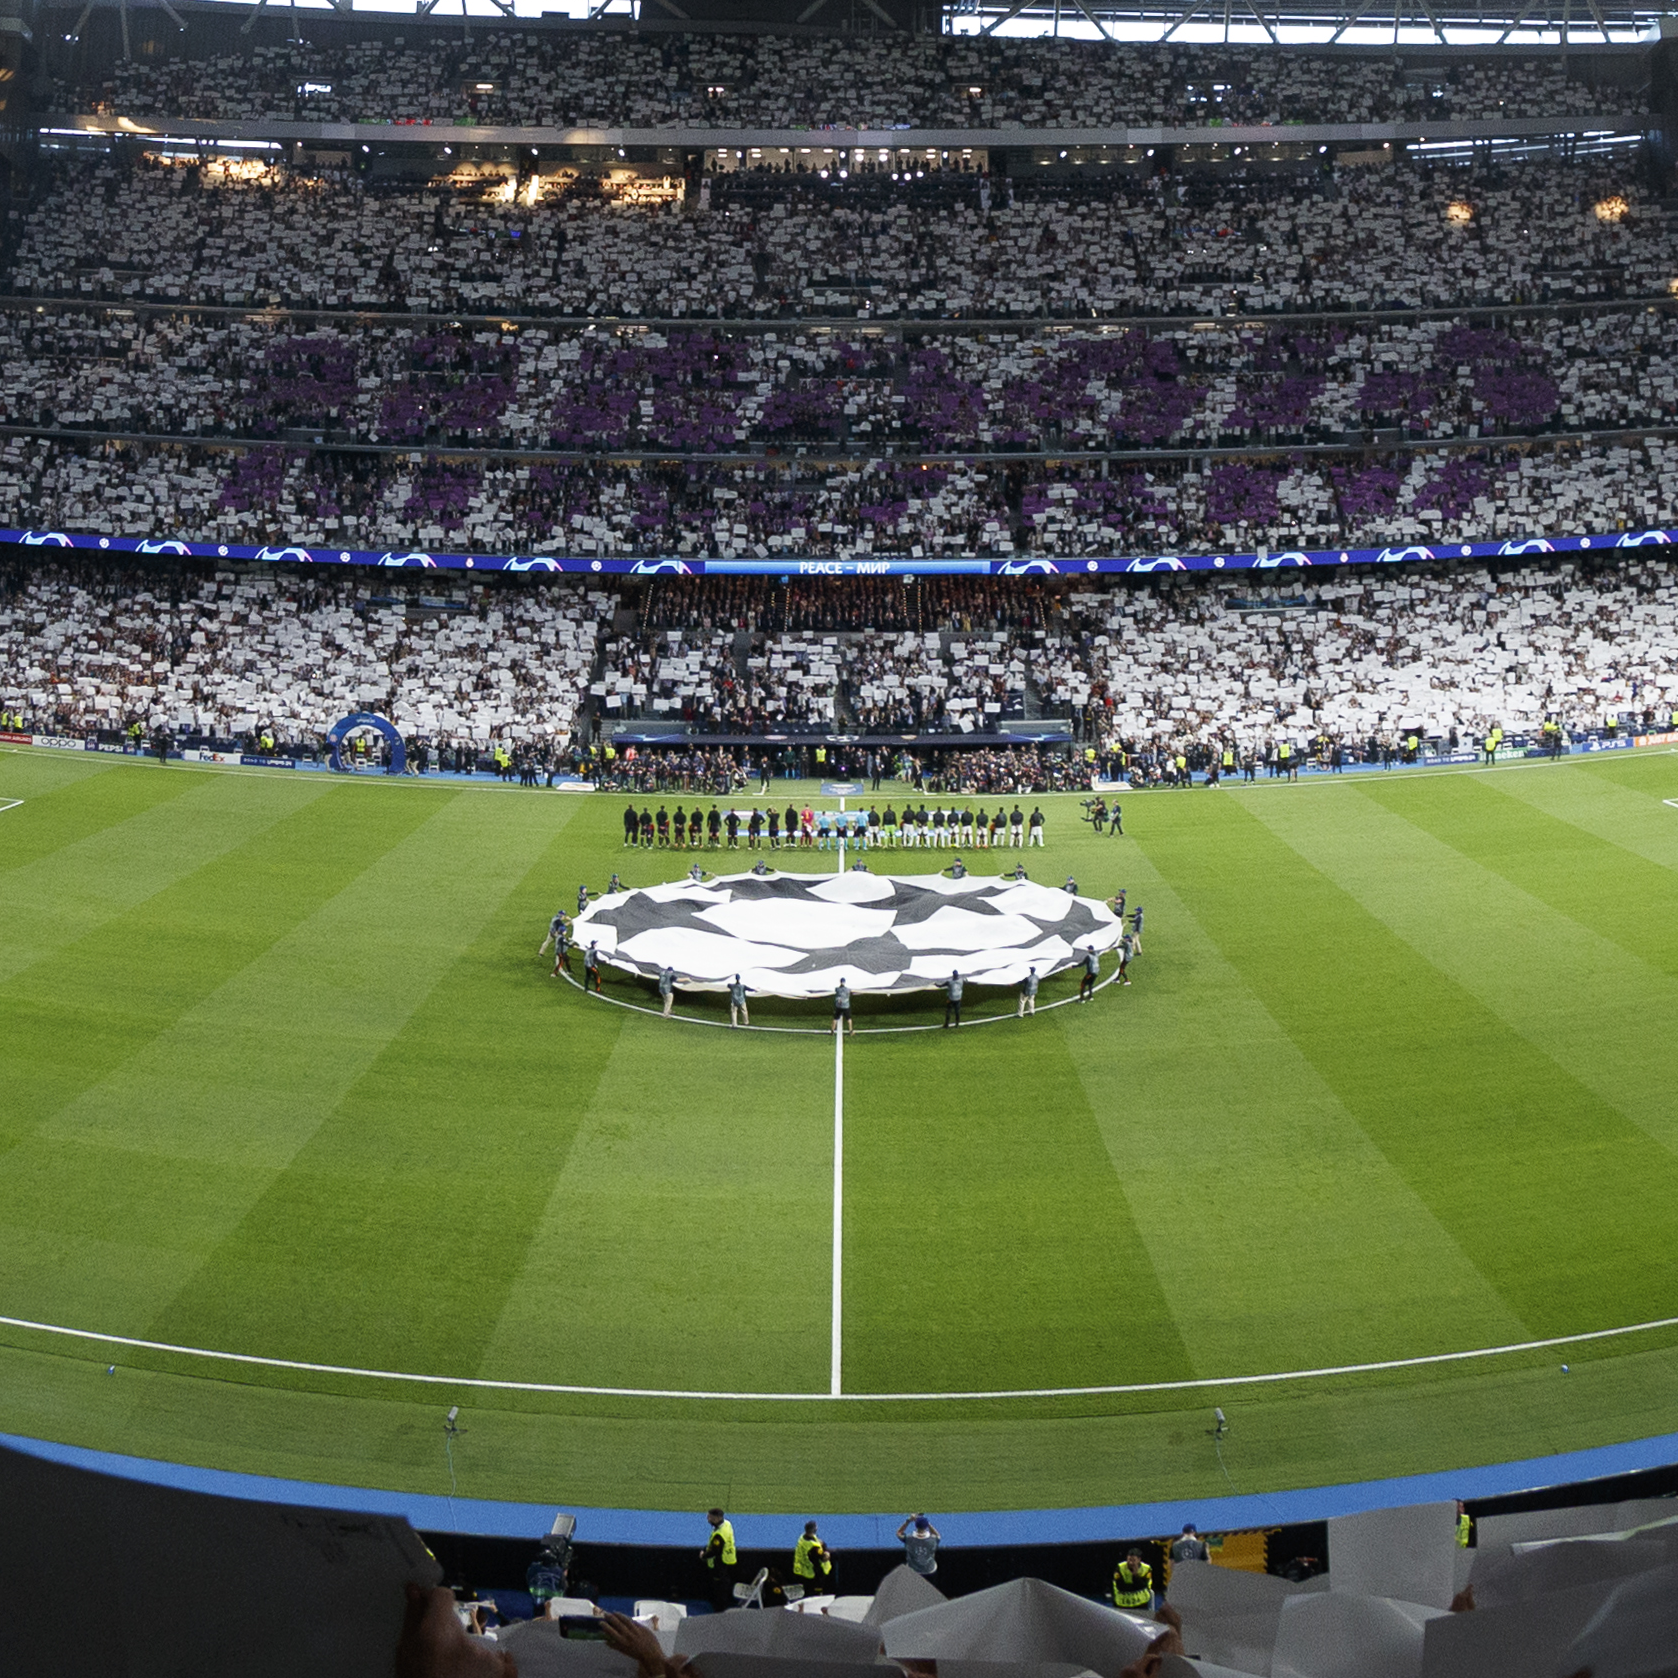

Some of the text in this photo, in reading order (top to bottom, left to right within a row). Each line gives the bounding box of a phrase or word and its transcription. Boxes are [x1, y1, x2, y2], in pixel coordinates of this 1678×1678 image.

[799, 562, 843, 574] PEACE
[40, 737, 76, 748] oppo
[98, 743, 124, 753] PEPSI
[199, 752, 225, 762] FedEx
